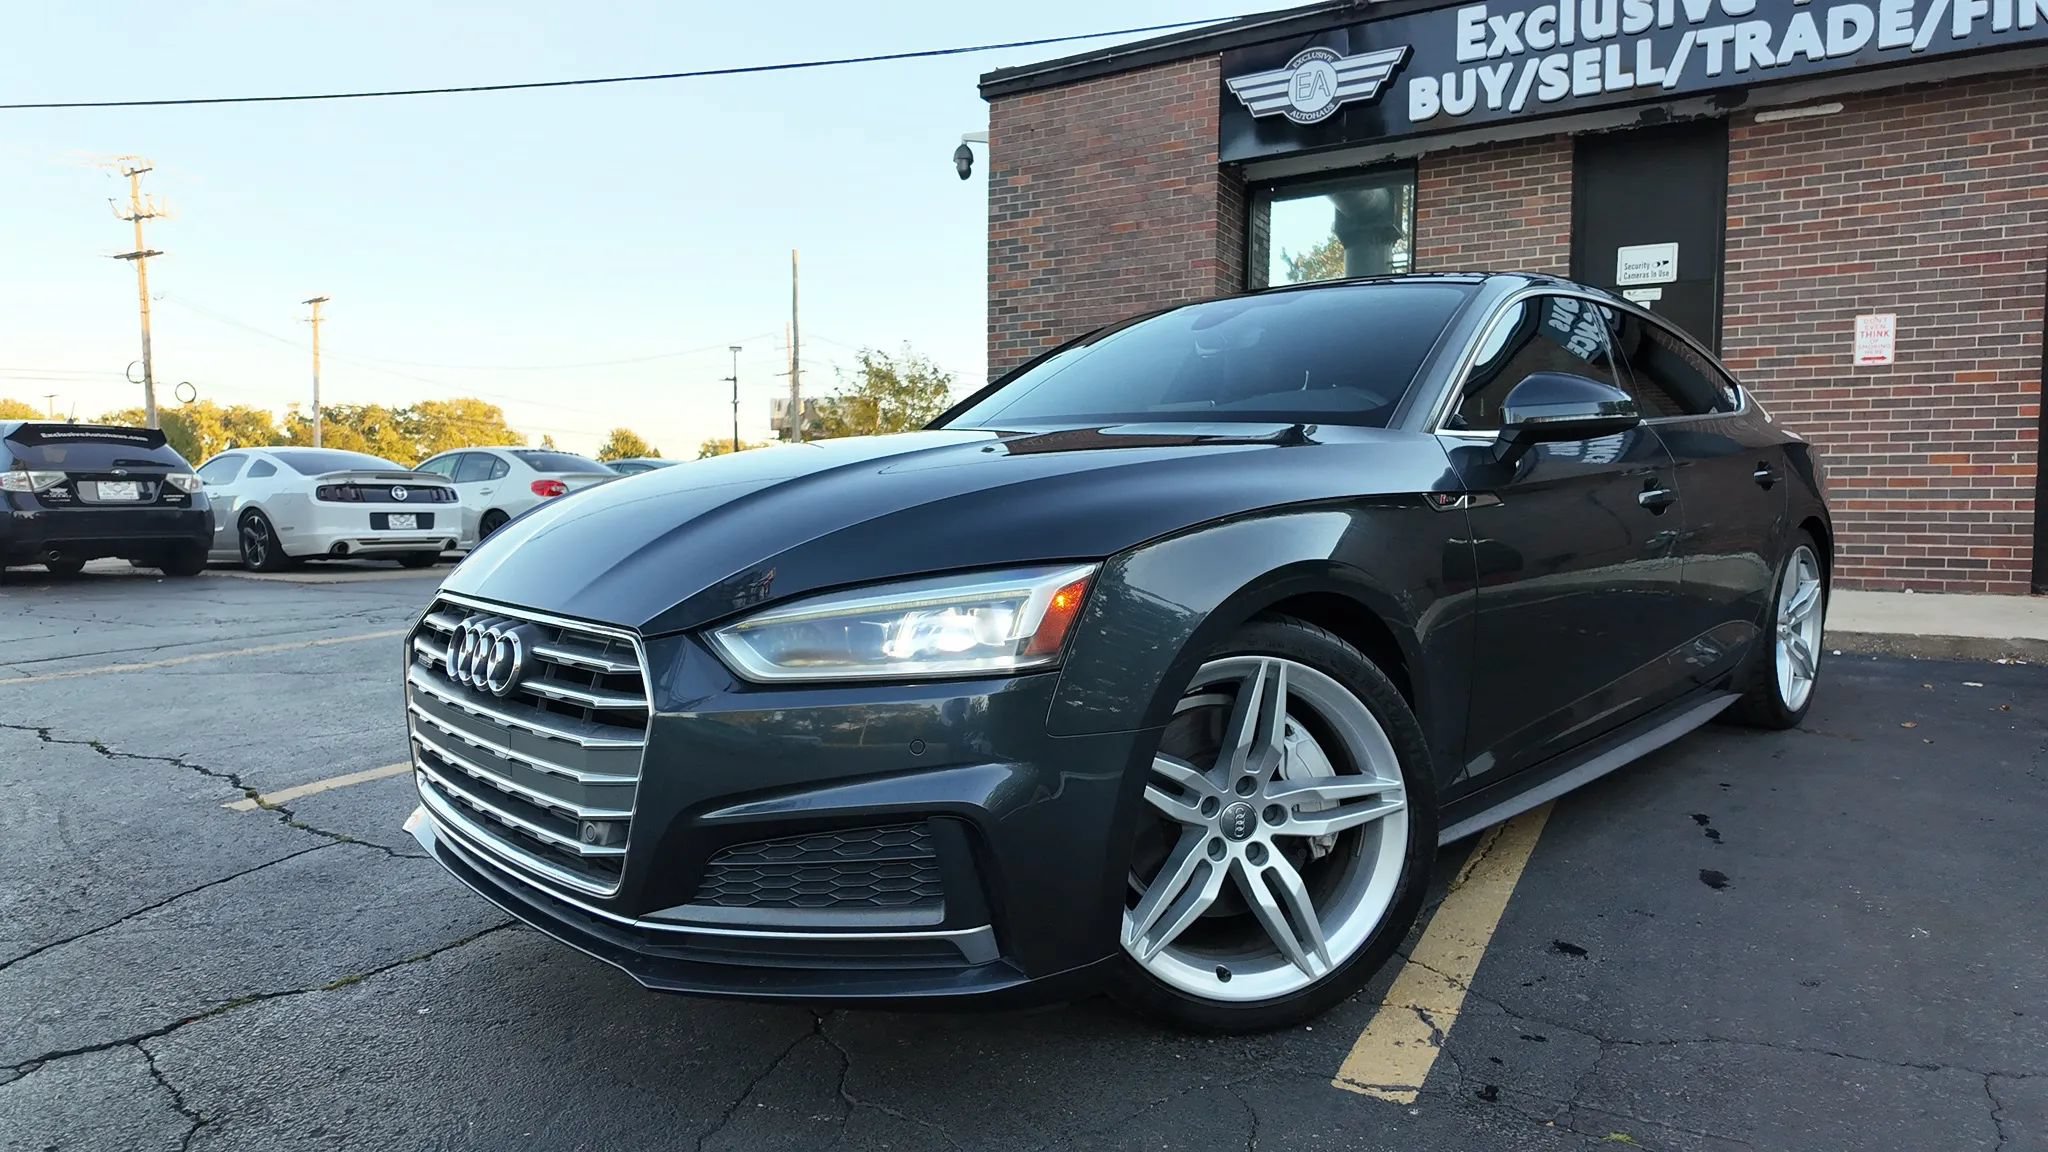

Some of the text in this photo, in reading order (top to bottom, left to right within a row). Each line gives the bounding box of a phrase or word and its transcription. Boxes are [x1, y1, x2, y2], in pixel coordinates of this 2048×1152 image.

[1292, 51, 1334, 68] EXCLUSIVE
[1295, 69, 1331, 102] EA
[1289, 103, 1336, 121] AUTOHAUS
[1624, 261, 1650, 271] Security
[1624, 272, 1649, 280] Cameras
[1658, 270, 1670, 278] Use
[1861, 330, 1889, 338] THINK
